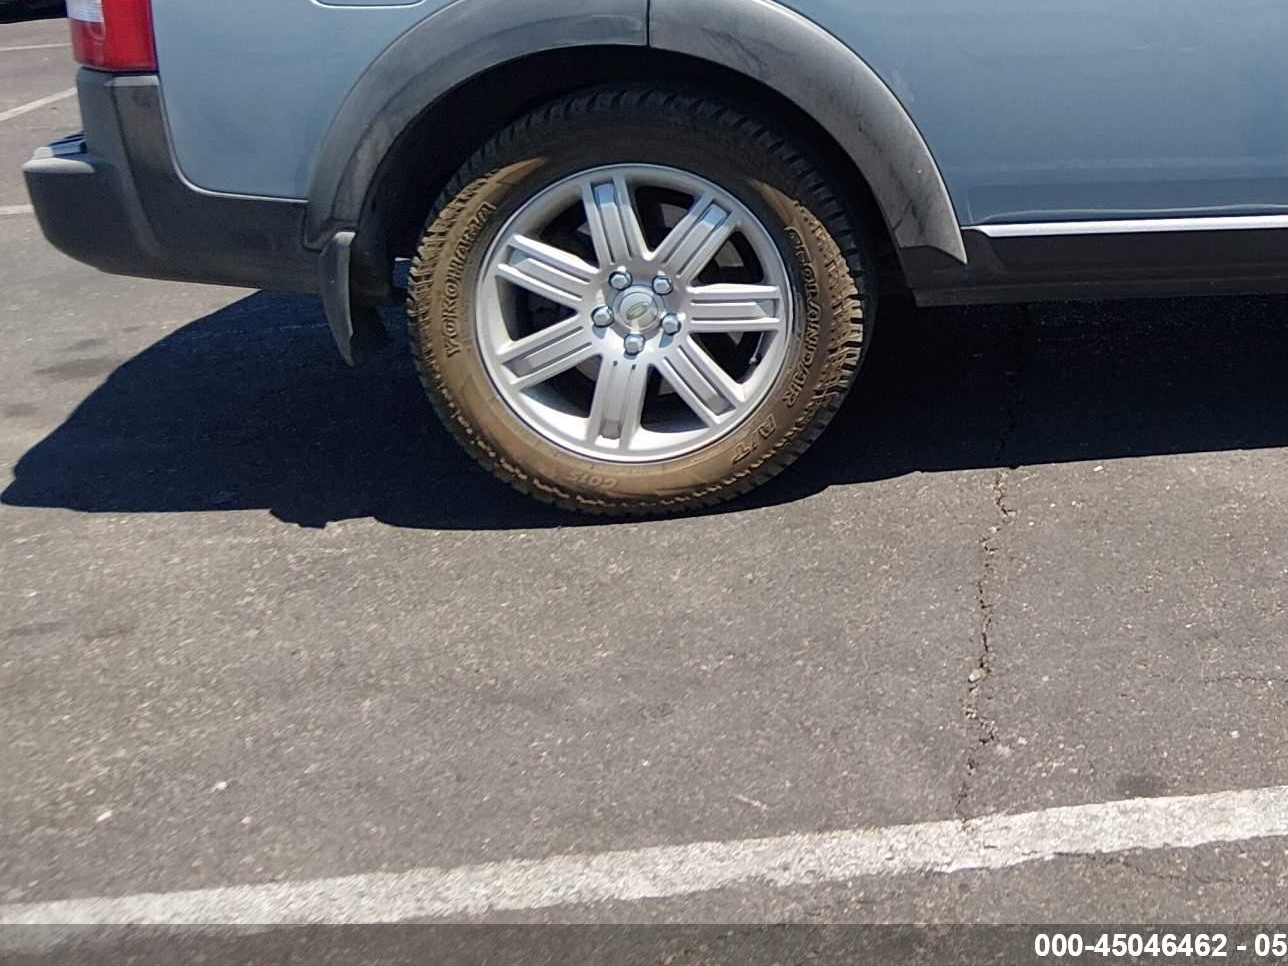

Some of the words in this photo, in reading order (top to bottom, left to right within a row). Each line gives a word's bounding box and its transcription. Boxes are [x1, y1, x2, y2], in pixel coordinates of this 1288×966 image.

[441, 201, 497, 358] YOKOHAMA
[782, 225, 823, 410] GEOLANDAR
[731, 414, 778, 466] A/T
